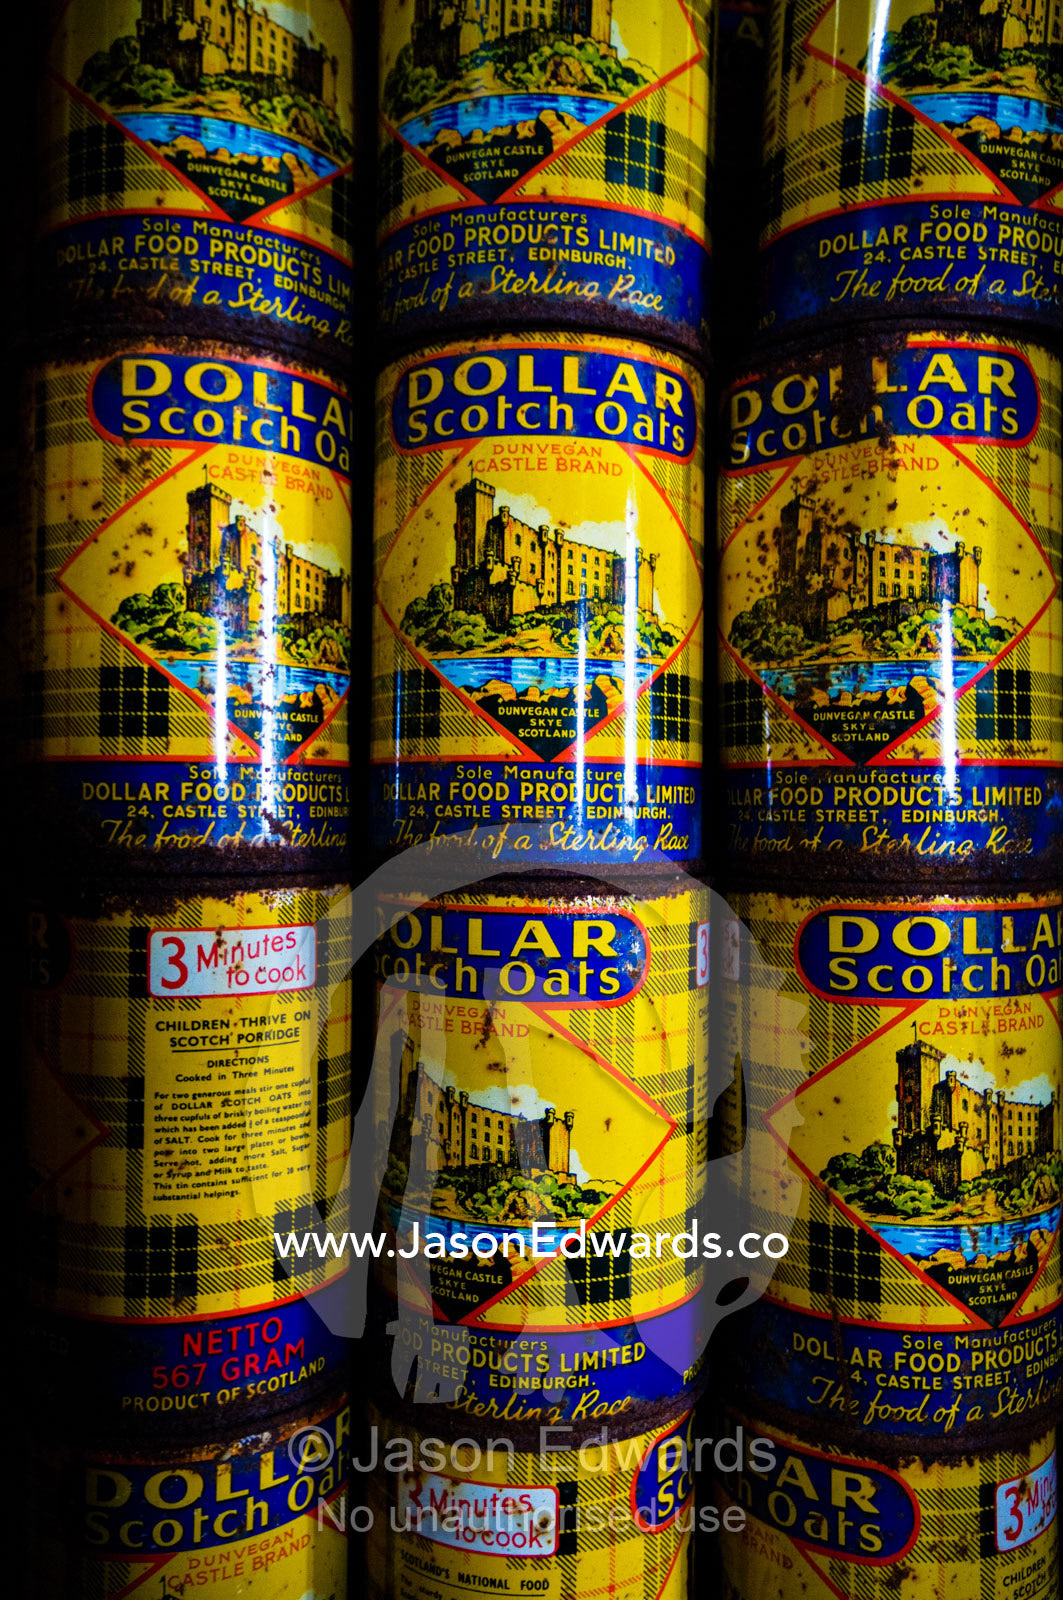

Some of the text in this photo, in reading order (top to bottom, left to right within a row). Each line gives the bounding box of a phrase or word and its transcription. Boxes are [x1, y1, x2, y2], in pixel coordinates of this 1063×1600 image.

[446, 146, 544, 163] DUNVEGAN CASTLE
[981, 144, 1037, 161] DUNVEGAN
[474, 159, 504, 169] SKYE
[1011, 160, 1040, 173] SKYE
[187, 162, 287, 192] DUNVEGAN CASTLE
[220, 178, 251, 191] SKYE
[463, 169, 519, 182] SCOTLAND
[1000, 169, 1050, 186] SCOTLAND
[208, 186, 265, 206] SCOTLAND
[930, 204, 971, 219] Sole
[413, 208, 587, 238] Sole Manufacturers
[143, 218, 321, 265] Sole Manufacturers
[408, 232, 454, 261] FOOD
[465, 224, 589, 247] PRODUCTS
[600, 229, 676, 266] LIMITED
[819, 223, 988, 259] DOLLAR FOOD
[135, 235, 323, 285] FOOD PRODUCTS
[900, 246, 966, 261] CASTLE
[118, 258, 180, 271] CASTLE
[481, 265, 664, 311] Sterling Race
[830, 263, 986, 303] The food of
[228, 283, 330, 335] Sterling
[408, 354, 684, 418] DOLLAR
[122, 359, 352, 441] DOLLA
[408, 395, 685, 452] Scotch Oats
[906, 395, 1019, 435] Oats
[122, 400, 300, 452] Scotch
[493, 443, 602, 457] DUNVEGAN
[227, 453, 320, 480] DUNVEGAN
[474, 457, 623, 477] CASTLE BRAND
[286, 477, 333, 500] BRAND
[499, 706, 558, 716] DUNVEGAN
[874, 710, 915, 720] CASTLE
[529, 718, 562, 727] SKYE
[842, 722, 875, 731] SKYE
[518, 729, 577, 738] SCOTLAND
[831, 733, 889, 742] SCOTLAND
[457, 765, 492, 779] Sole
[776, 771, 807, 784] Sole
[82, 782, 246, 802] DOLLAR FOOD
[450, 782, 510, 802] FOOD
[646, 785, 695, 804] LIMITED
[770, 786, 1042, 807] FOOD PRODUCTS LIMITED
[163, 805, 227, 818] CASTLE
[435, 805, 491, 817] CASTLE
[100, 820, 147, 848] The
[549, 821, 649, 861] Sterling
[161, 931, 296, 989] 3 Minutes
[226, 954, 306, 988] to cook
[499, 960, 621, 997] Oats
[829, 956, 1011, 994] Scotch
[156, 1011, 311, 1032] CHILDREN THRIVE ON
[998, 1014, 1044, 1033] BRAND
[170, 1027, 300, 1047] SCOTCH PORRIDGE
[207, 1056, 269, 1068] DIRECTIONS
[176, 1065, 294, 1083] Cooked Three Minutes
[171, 1092, 292, 1111] DOLLAR SCOTCH OATS
[192, 1090, 231, 1100] generous
[180, 1113, 210, 1123] cupfuls
[154, 1125, 179, 1133] which
[197, 1135, 220, 1143] Cook
[209, 1157, 237, 1165] adding
[214, 1167, 232, 1175] Milk
[154, 1179, 227, 1190] This contains
[153, 1192, 201, 1201] substantial
[439, 1277, 466, 1290] SKYE
[465, 1270, 503, 1285] CASTLE
[948, 1272, 1003, 1286] DUNVEGAN
[430, 1284, 479, 1303] SCOTLAND
[968, 1291, 1018, 1306] SCOTLAND
[184, 1317, 282, 1357] NETTO
[418, 1317, 547, 1351] Manufacturers
[903, 1317, 1057, 1351] Sole Manufacturers
[431, 1339, 550, 1373] PRODUCTS
[560, 1341, 646, 1373] LIMITED
[894, 1328, 1057, 1373] FOOD PRODUCTS
[152, 1337, 304, 1389] 567 GRAM
[122, 1357, 325, 1413] PRODUCT OF SCOTLAND
[875, 1373, 942, 1390] CASTLE
[446, 1385, 632, 1425] Sterling Race
[863, 1390, 929, 1426] food
[429, 1487, 532, 1521] Minutes
[85, 1495, 269, 1549] Scotch
[768, 1490, 883, 1552] Oats
[482, 1519, 543, 1549] cook
[189, 1527, 295, 1570] DUNVEGAN
[251, 1533, 311, 1572] BRAND
[458, 1571, 511, 1590] NATIONAL
[520, 1579, 550, 1591] FOOD
[1002, 1555, 1047, 1587] CHILDREN
